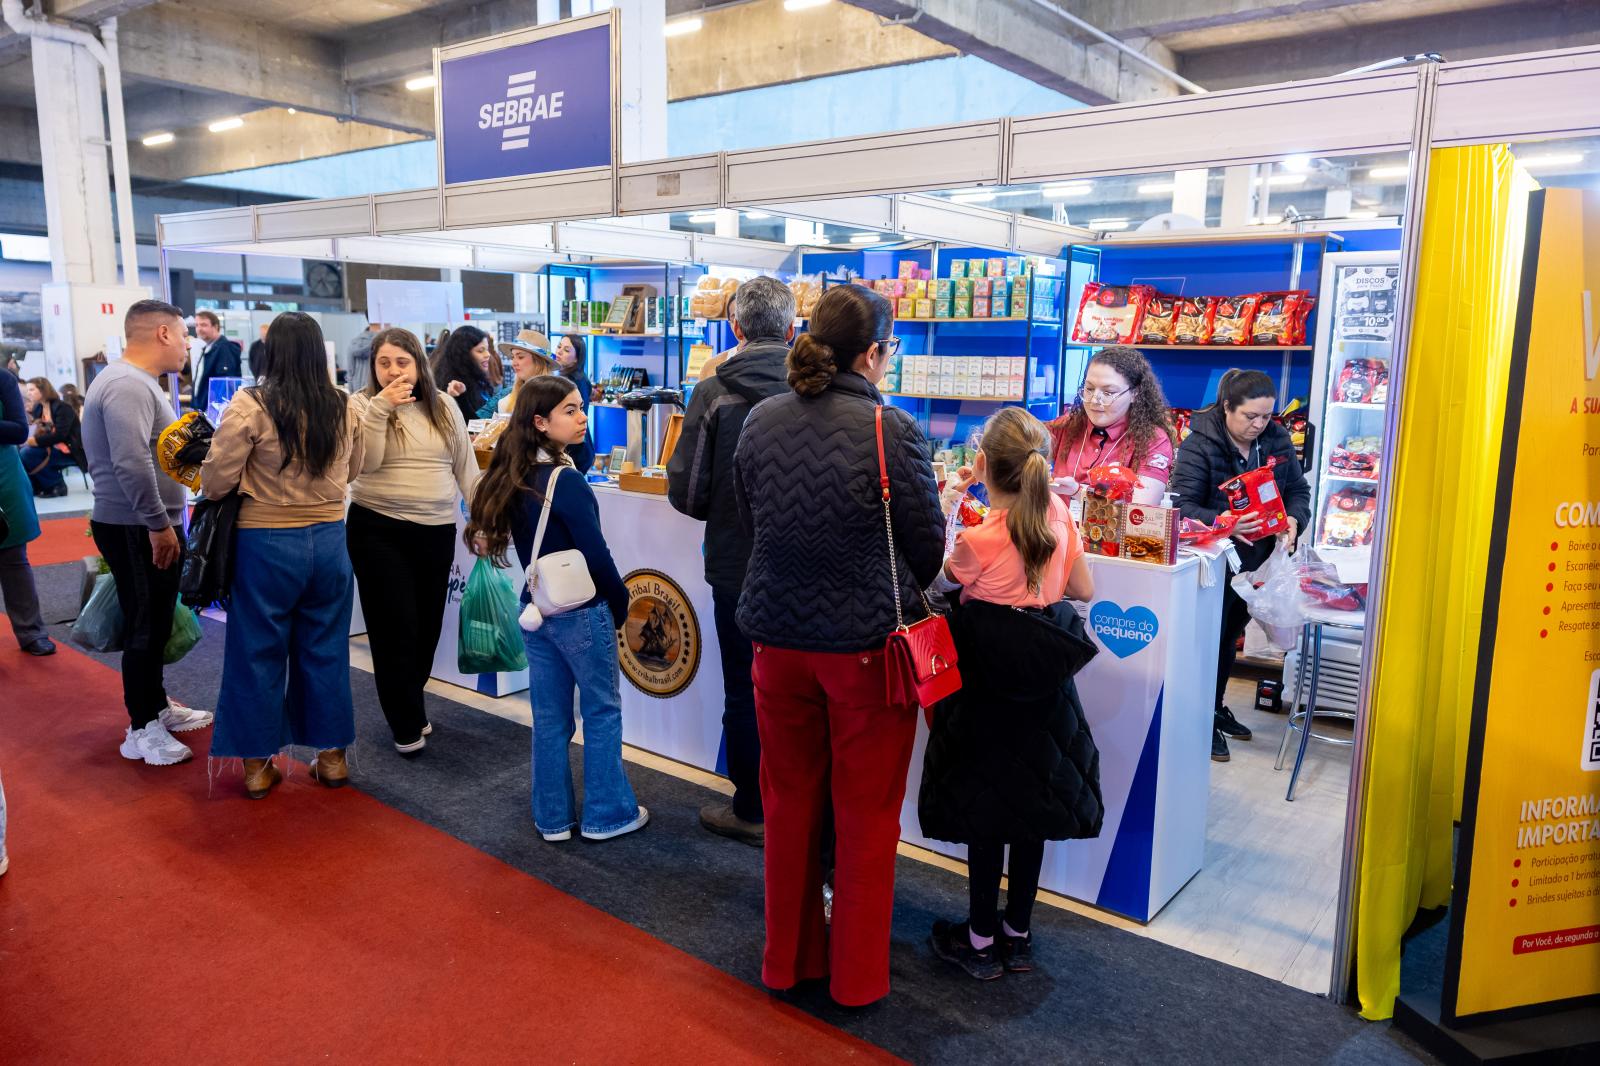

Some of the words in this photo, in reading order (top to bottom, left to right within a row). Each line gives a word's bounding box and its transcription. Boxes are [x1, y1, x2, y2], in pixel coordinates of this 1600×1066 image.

[478, 91, 564, 129] SEBRAE
[1570, 397, 1578, 414] A
[1582, 443, 1600, 457] Par
[1568, 541, 1590, 551] Baixe
[1591, 543, 1597, 551] o
[1563, 580, 1582, 593] Faça
[1583, 582, 1597, 591] seu
[653, 582, 681, 612] Brasil
[1094, 614, 1136, 629] compre
[1138, 619, 1154, 632] do
[1559, 621, 1590, 632] Resgate
[1094, 624, 1153, 643] pequeno
[1531, 853, 1579, 868] Participação
[1529, 873, 1562, 887] Limitado
[1570, 871, 1576, 882] 1
[1527, 892, 1556, 905] Brindes
[1556, 887, 1585, 902] sujeitos
[1522, 939, 1534, 949] Por
[1535, 935, 1554, 946] Você,
[1554, 933, 1563, 944] de
[1564, 929, 1593, 943] segunda
